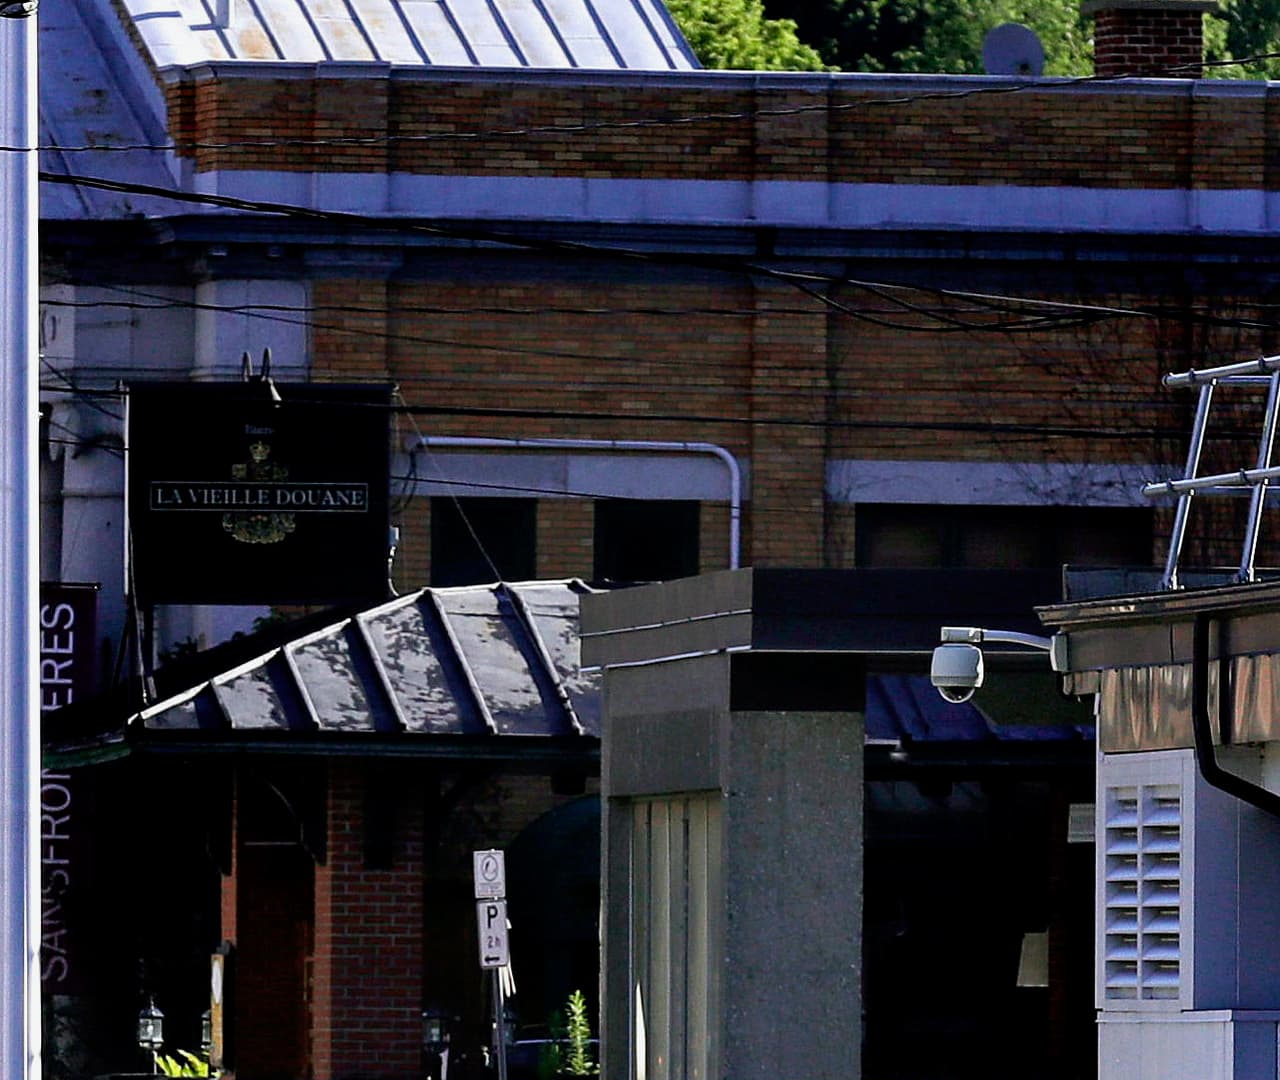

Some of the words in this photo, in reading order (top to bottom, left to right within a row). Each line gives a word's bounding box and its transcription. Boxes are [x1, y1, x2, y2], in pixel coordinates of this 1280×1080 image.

[157, 488, 184, 505] LA
[188, 489, 270, 505] VIEILLE
[276, 490, 365, 507] DOUANE
[486, 905, 499, 929] P
